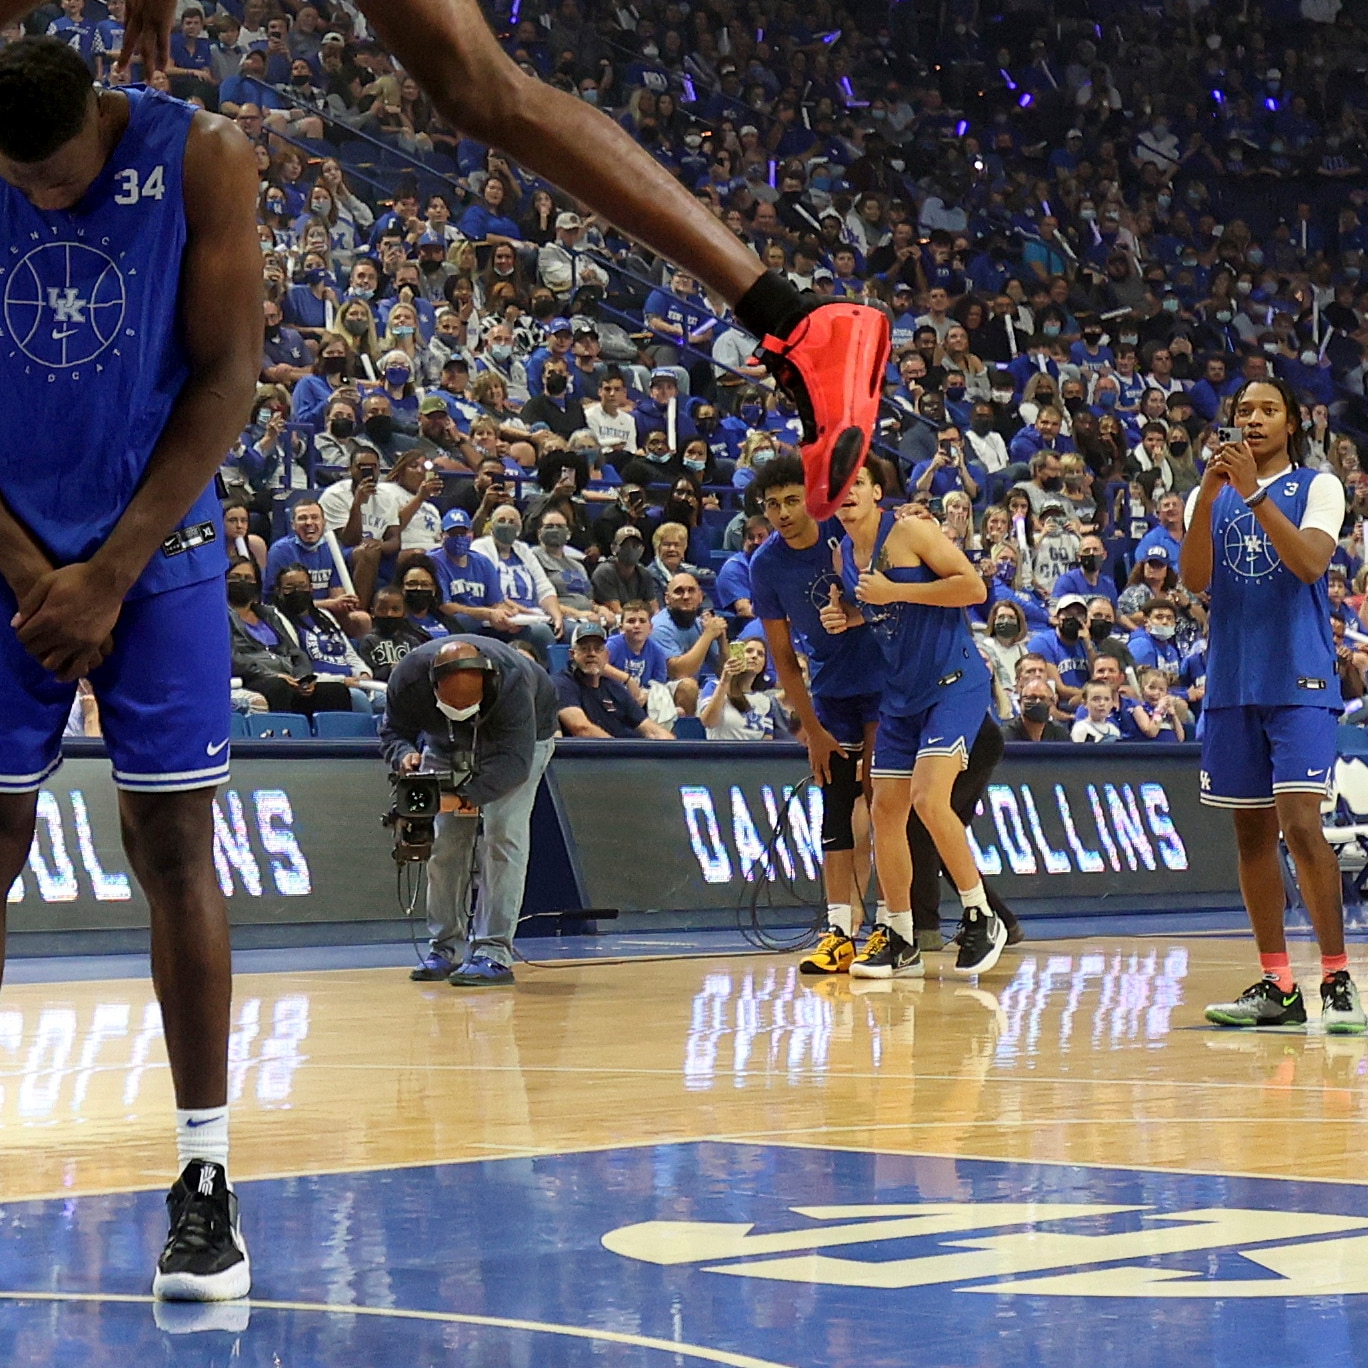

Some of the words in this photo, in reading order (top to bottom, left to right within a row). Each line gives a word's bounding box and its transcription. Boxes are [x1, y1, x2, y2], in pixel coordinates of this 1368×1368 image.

[113, 165, 166, 205] 34
[46, 286, 88, 323] UK
[1283, 481, 1300, 497] 3
[1049, 546, 1068, 562] GO
[1243, 535, 1263, 555] UK
[1040, 563, 1072, 579] CAT
[1199, 769, 1212, 792] UK
[679, 783, 824, 884] DAIM
[6, 789, 313, 903] OLNS
